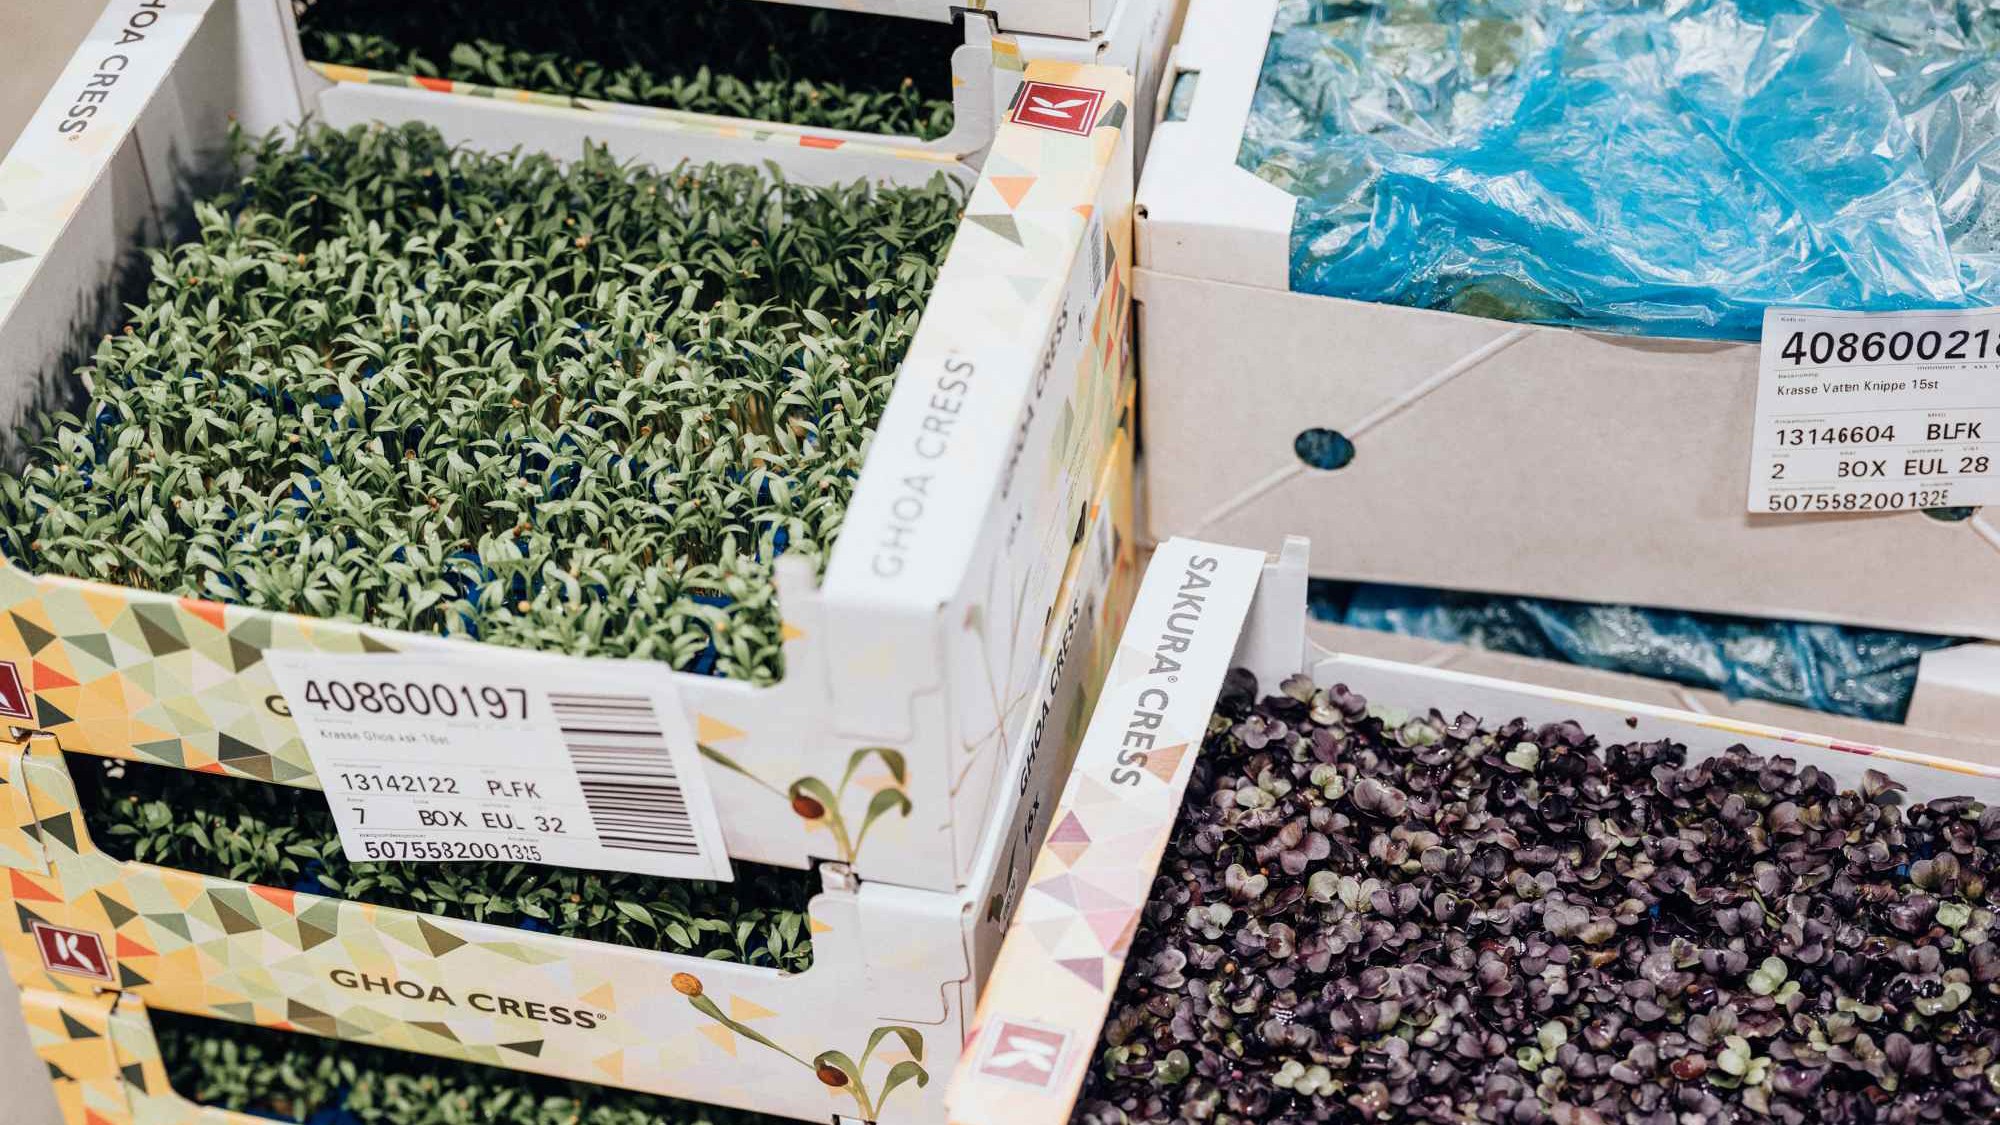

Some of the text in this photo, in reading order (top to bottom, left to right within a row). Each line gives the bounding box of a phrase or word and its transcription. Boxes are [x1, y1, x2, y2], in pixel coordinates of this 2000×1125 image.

[1780, 329, 2000, 365] 40860021
[1777, 384, 1818, 396] Krasse
[1864, 379, 1906, 393] Knippe
[1911, 378, 1939, 390] 15st
[1776, 422, 1982, 446] 13146604 BLFK
[1771, 456, 1990, 479] 2 BOX EUL 28
[872, 475, 934, 578] GHOA
[305, 680, 528, 720] 408600197
[1020, 699, 1050, 797] GHOA
[1110, 688, 1169, 787] CRESS
[341, 773, 541, 799] 13142122 PLFK
[352, 807, 567, 833] 7 BOX EUL 32
[329, 968, 457, 1007] GHOA
